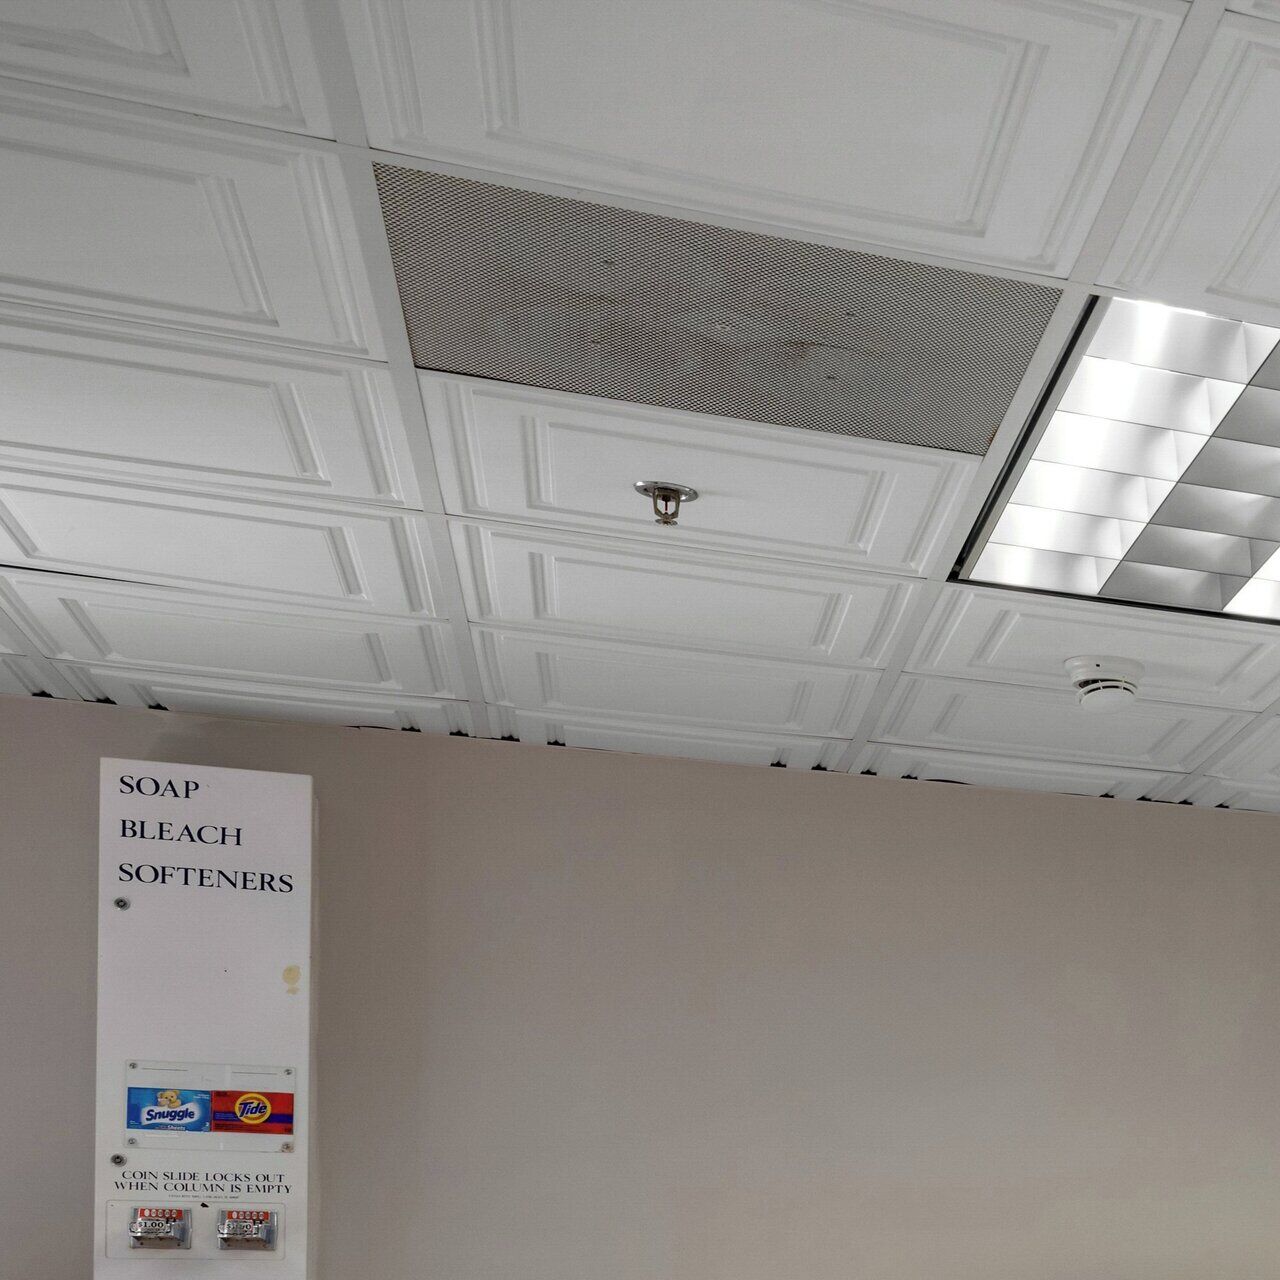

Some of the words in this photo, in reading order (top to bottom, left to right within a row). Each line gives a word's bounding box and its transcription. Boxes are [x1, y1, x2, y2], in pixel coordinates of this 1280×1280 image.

[119, 775, 200, 799] SOAP
[120, 818, 243, 846] BLEACH
[118, 862, 293, 893] SOFTENERS
[146, 1107, 195, 1121] Snuggle
[238, 1101, 267, 1118] Tide
[122, 1171, 159, 1181] COIN
[163, 1171, 200, 1181] SLIDE
[205, 1172, 251, 1182] LOCKS
[255, 1173, 285, 1183] OUT
[114, 1181, 159, 1191] WHEN
[164, 1182, 225, 1193] COLUMN
[231, 1184, 242, 1193] IS
[246, 1184, 292, 1194] EMPTY
